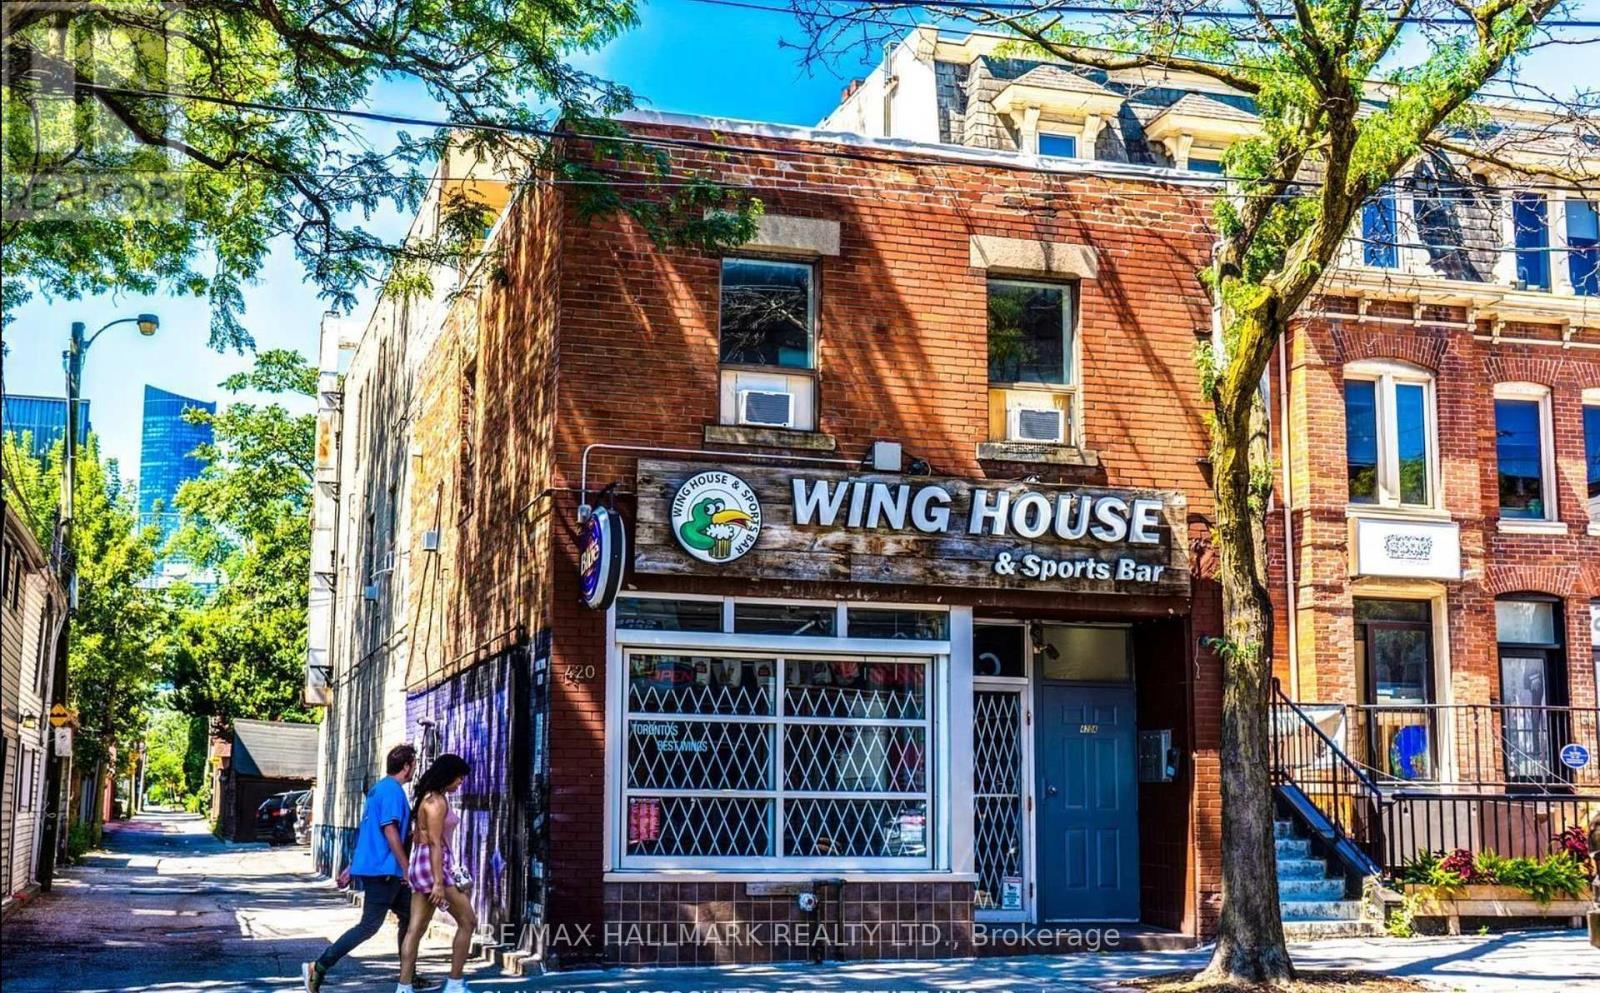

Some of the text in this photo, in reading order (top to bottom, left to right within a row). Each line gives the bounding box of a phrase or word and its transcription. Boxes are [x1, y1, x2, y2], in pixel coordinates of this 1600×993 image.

[673, 474, 759, 555] WING HOUSE & SPORTS BAR
[792, 478, 1165, 545] WING HOUSE
[994, 552, 1164, 583] & Sports Bar
[565, 665, 595, 679] 420
